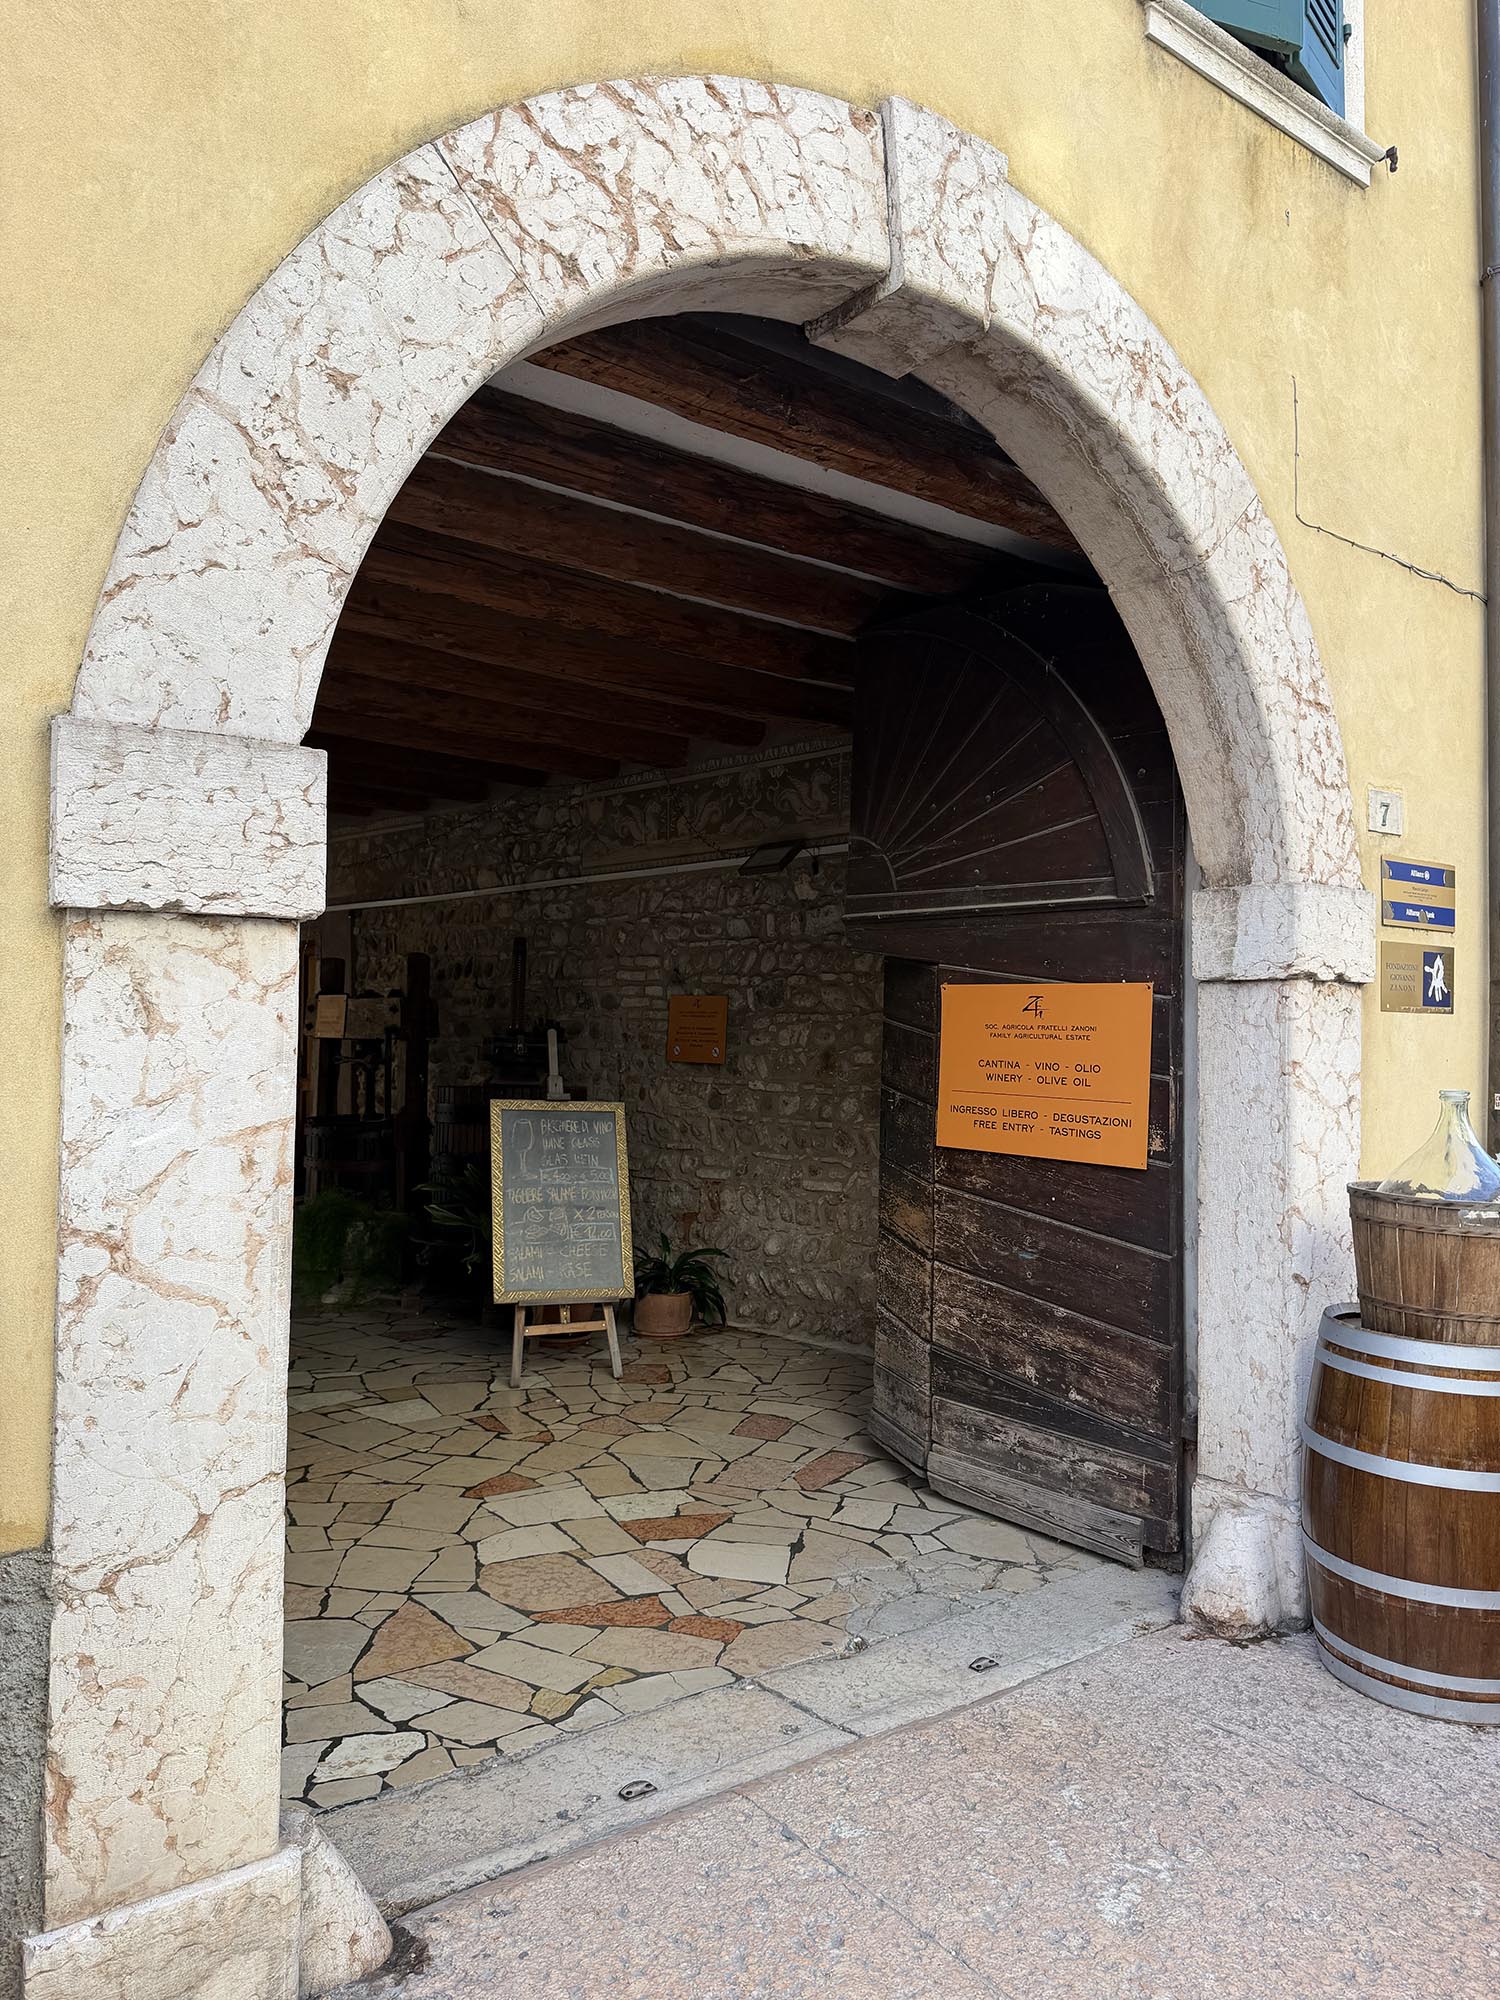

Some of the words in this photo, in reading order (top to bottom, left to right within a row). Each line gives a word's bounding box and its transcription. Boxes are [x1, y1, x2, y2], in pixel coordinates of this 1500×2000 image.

[1380, 802, 1390, 827] 7
[1037, 1024, 1068, 1032] FRATELLI
[978, 1059, 1021, 1070] CANTINA
[1034, 1062, 1060, 1072] VINO
[1074, 1063, 1101, 1074] OLIO
[985, 1073, 1023, 1083] WINERY
[1036, 1075, 1067, 1086] OLIVE
[1073, 1077, 1091, 1087] OIL
[950, 1105, 998, 1117] INGRESSO
[1002, 1109, 1039, 1120] LIBERO
[1053, 1112, 1132, 1128] DEGUSTAZIONI
[593, 1120, 613, 1135] VINO
[973, 1119, 997, 1130] FREE
[1002, 1122, 1035, 1133] ENTRY
[1049, 1126, 1102, 1140] TASTINGS
[586, 1206, 596, 1220] 2
[559, 1243, 609, 1258] CHEESE
[509, 1266, 545, 1282] SALAMI
